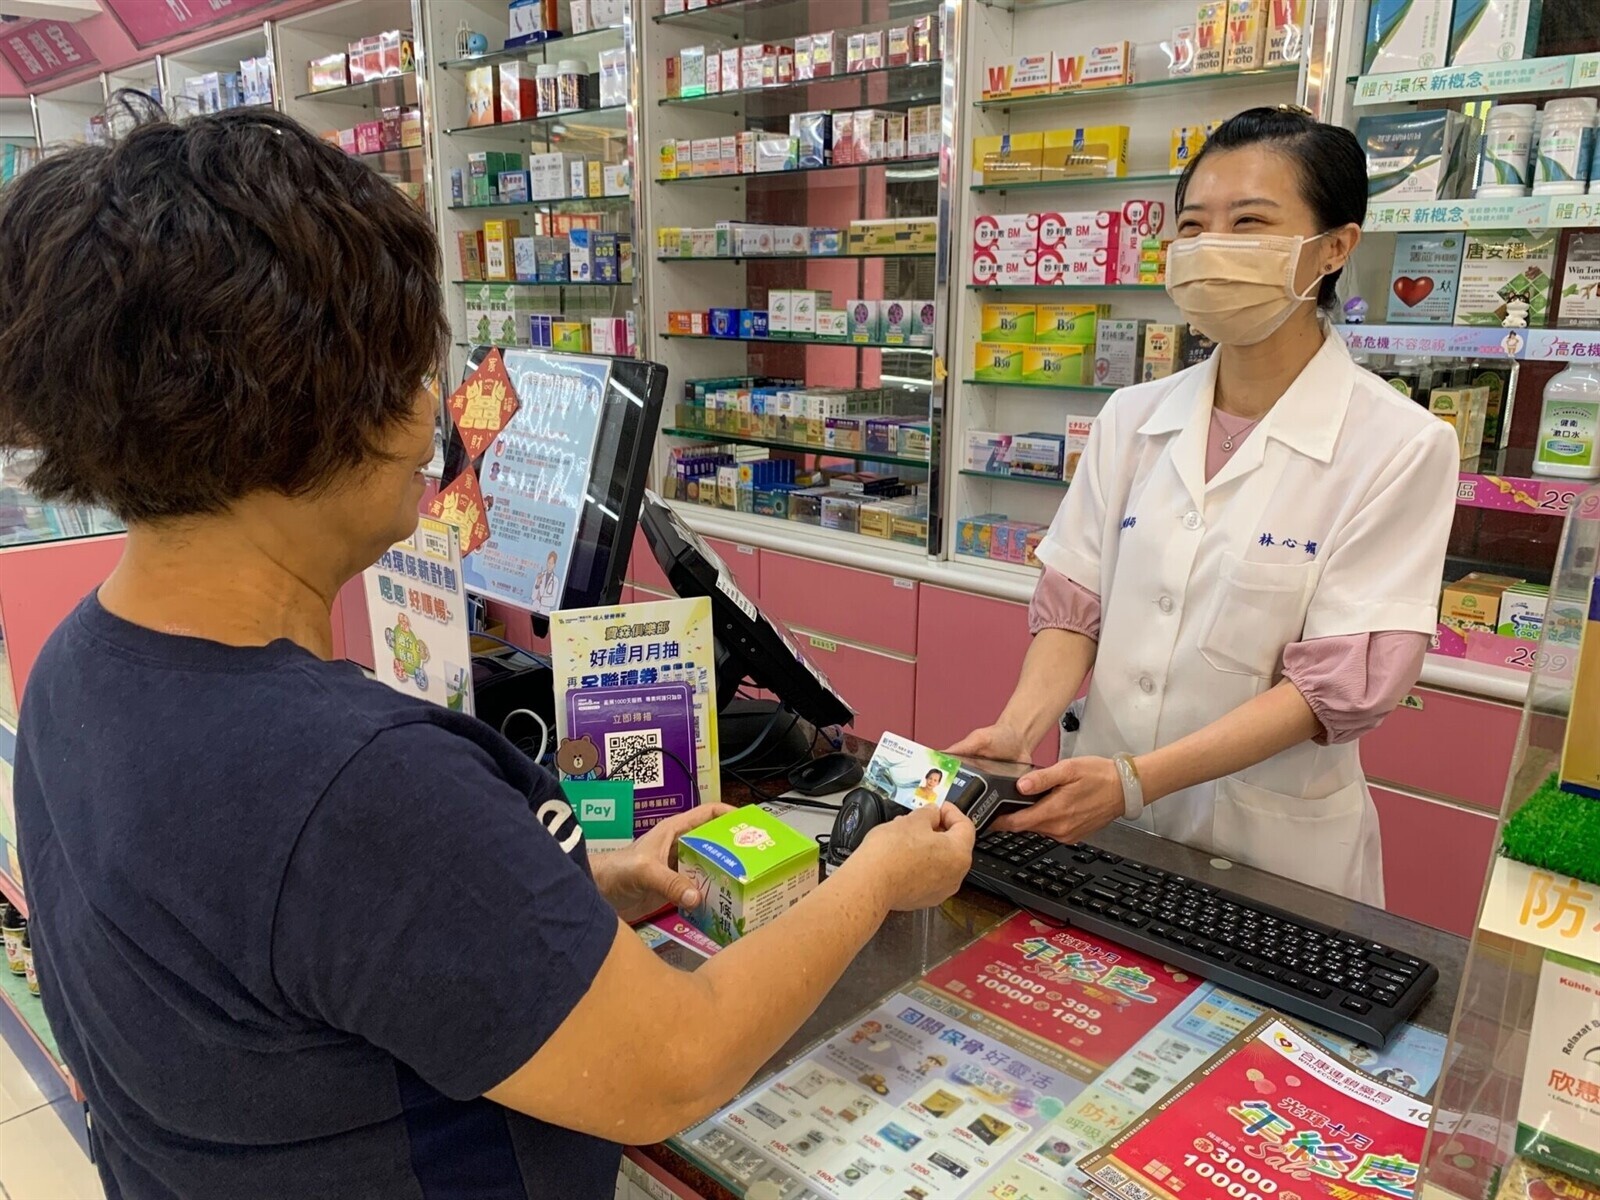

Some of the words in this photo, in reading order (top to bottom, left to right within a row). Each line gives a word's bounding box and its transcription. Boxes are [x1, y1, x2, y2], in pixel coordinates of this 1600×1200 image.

[989, 64, 1014, 92] W
[1058, 55, 1085, 84] W
[1008, 228, 1021, 238] BM
[1076, 226, 1090, 236] BM
[1006, 263, 1019, 273] BM
[1073, 262, 1087, 272] BM
[1568, 266, 1584, 274] Win
[1000, 318, 1017, 330] B50
[1057, 319, 1075, 331] B50
[994, 356, 1011, 368] B50
[1043, 359, 1061, 371] B50
[374, 550, 456, 591] 內環保新計劃
[589, 641, 679, 668] 好禮月月抽
[586, 804, 611, 817] Pay
[1519, 871, 1600, 939] 防
[997, 970, 1046, 994] 3000
[1061, 997, 1102, 1020] 399
[1560, 977, 1591, 994] Kühle
[976, 974, 1034, 1005] 10000
[1052, 1007, 1102, 1036] 1899
[1562, 1022, 1592, 1056] Relaxat
[1298, 1057, 1342, 1087] WHOLECOME
[1344, 1085, 1386, 1106] PHARMACY
[1300, 1051, 1393, 1103] 合康連鎖藥局
[1277, 1097, 1375, 1150] 光輝十月
[1209, 1147, 1278, 1194] 3000
[1243, 1141, 1316, 1182] Sale
